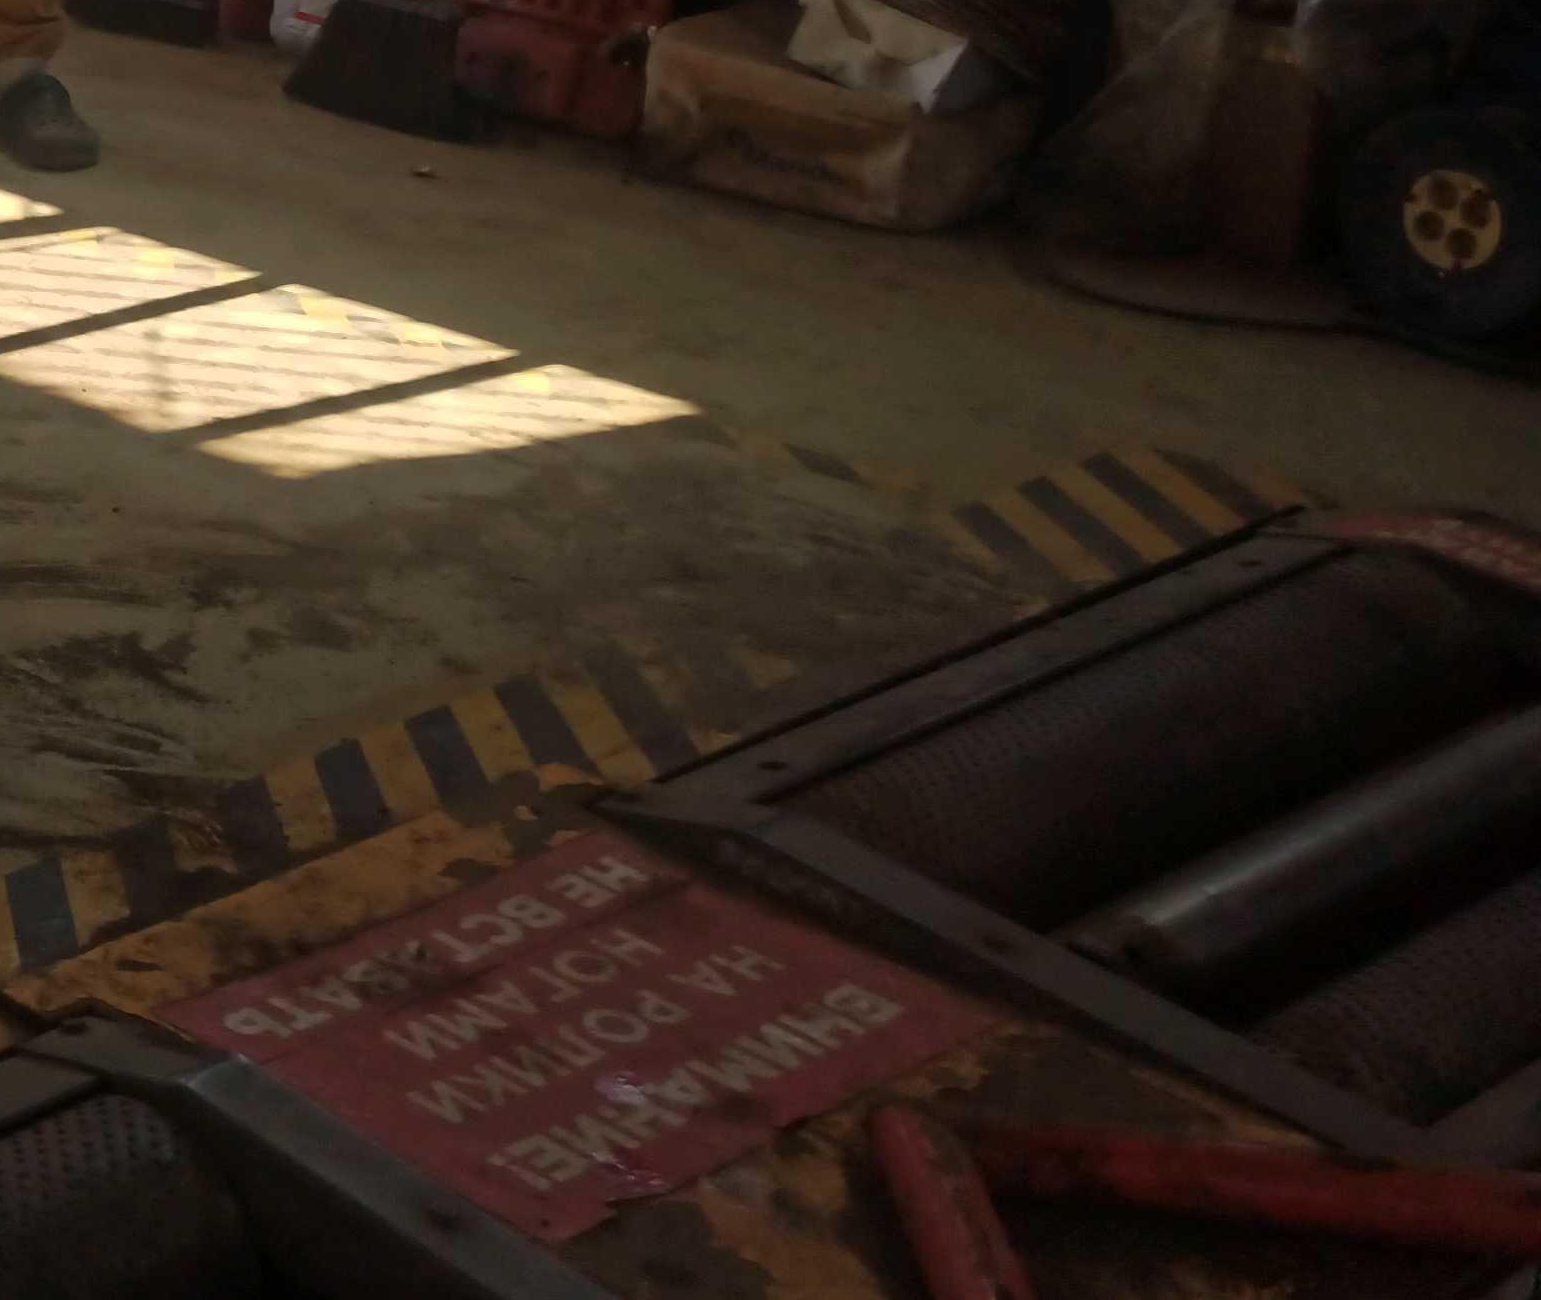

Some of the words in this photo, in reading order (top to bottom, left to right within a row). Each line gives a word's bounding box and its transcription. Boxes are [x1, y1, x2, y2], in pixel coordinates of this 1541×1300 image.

[562, 853, 652, 910] НЕ
[381, 926, 667, 1063] НОГАМИ
[672, 943, 787, 998] НА
[405, 988, 692, 1126] РОЛИКИ
[484, 980, 909, 1192] ВНИМАНИЕ!
